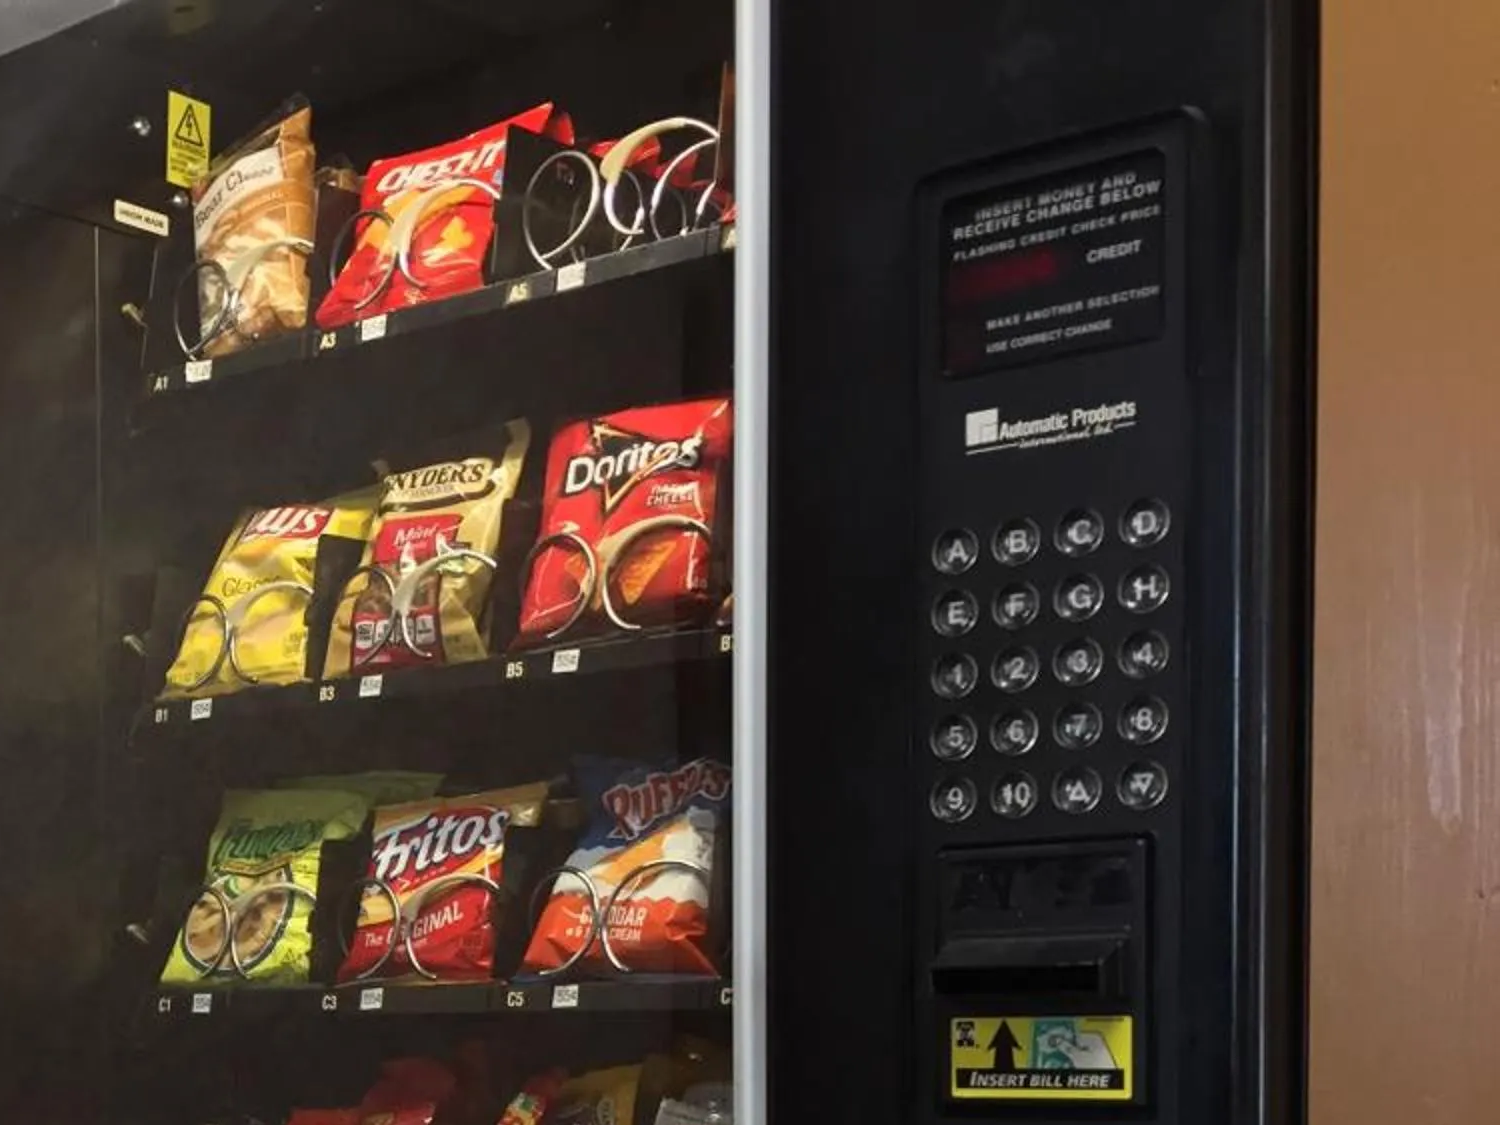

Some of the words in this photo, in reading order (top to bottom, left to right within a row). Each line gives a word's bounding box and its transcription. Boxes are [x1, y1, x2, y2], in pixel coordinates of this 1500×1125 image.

[976, 195, 1032, 221] INSERT
[1038, 184, 1095, 207] MONEY
[1101, 172, 1137, 191] AND
[953, 213, 1021, 241] RECEIVE
[1026, 197, 1094, 224] CHANGE
[1099, 179, 1162, 206] BELOW
[953, 239, 1016, 262] FLASHING
[1020, 226, 1067, 248] CREDIT
[1071, 216, 1116, 236] CHECK
[1120, 204, 1162, 224] PRICE
[1086, 240, 1141, 264] CREDIT
[508, 282, 530, 303] A5
[986, 313, 1020, 331] MAKE
[1025, 300, 1084, 322] ANOTHER
[1088, 285, 1160, 310] SELECTION
[320, 333, 337, 349] A3
[986, 340, 1007, 353] USE
[1010, 329, 1062, 349] CORRECT
[1064, 319, 1113, 338] CHANGE
[153, 376, 170, 392] A1
[999, 411, 1068, 440] Automatic
[1072, 401, 1137, 427] Products
[565, 438, 701, 494] Doritos
[1069, 519, 1093, 544] C
[1133, 510, 1157, 535] D
[948, 539, 968, 563] A
[1007, 529, 1028, 553] B
[1069, 583, 1092, 609] G
[1133, 575, 1158, 600] H
[948, 601, 966, 625] E
[1006, 593, 1026, 616] F
[1071, 649, 1088, 673] 3
[1133, 642, 1152, 664] 4
[506, 661, 524, 678] B5
[952, 664, 963, 684] 1
[1008, 656, 1027, 679] 2
[319, 686, 336, 702] B3
[155, 708, 169, 723] B1
[1071, 714, 1087, 737] 7
[1136, 707, 1152, 731] 8
[948, 726, 964, 747] 5
[1007, 719, 1024, 743] 6
[948, 786, 964, 809] 9
[1001, 781, 1030, 807] 10
[372, 810, 510, 883] Fritos
[364, 931, 384, 948] The
[609, 928, 642, 943] CREAM
[158, 998, 171, 1013] C1
[322, 994, 338, 1010] C3
[507, 991, 524, 1007] C5
[969, 1071, 1026, 1088] INSERT
[1028, 1071, 1063, 1088] BILL
[1066, 1073, 1111, 1089] HERE
